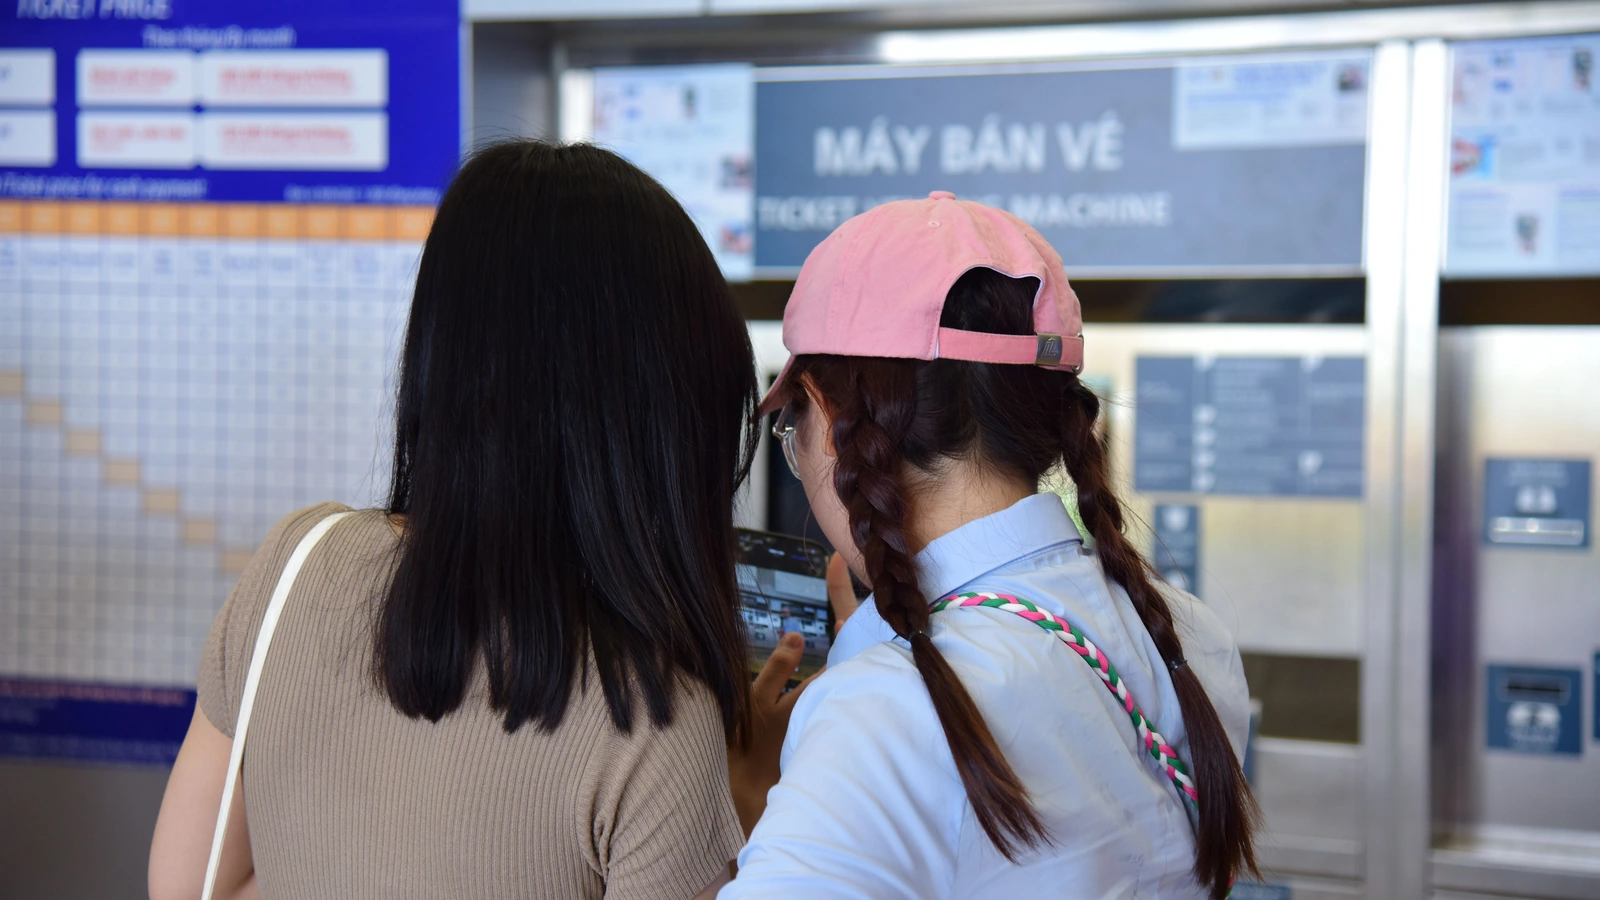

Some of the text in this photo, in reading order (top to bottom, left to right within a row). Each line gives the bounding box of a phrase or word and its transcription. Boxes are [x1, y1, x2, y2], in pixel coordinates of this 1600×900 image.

[815, 116, 929, 175] MÁY
[939, 114, 1046, 174] BÁN
[1056, 110, 1124, 171] VÉ
[758, 196, 858, 231] TICKET
[1008, 193, 1171, 227] MACHINE
